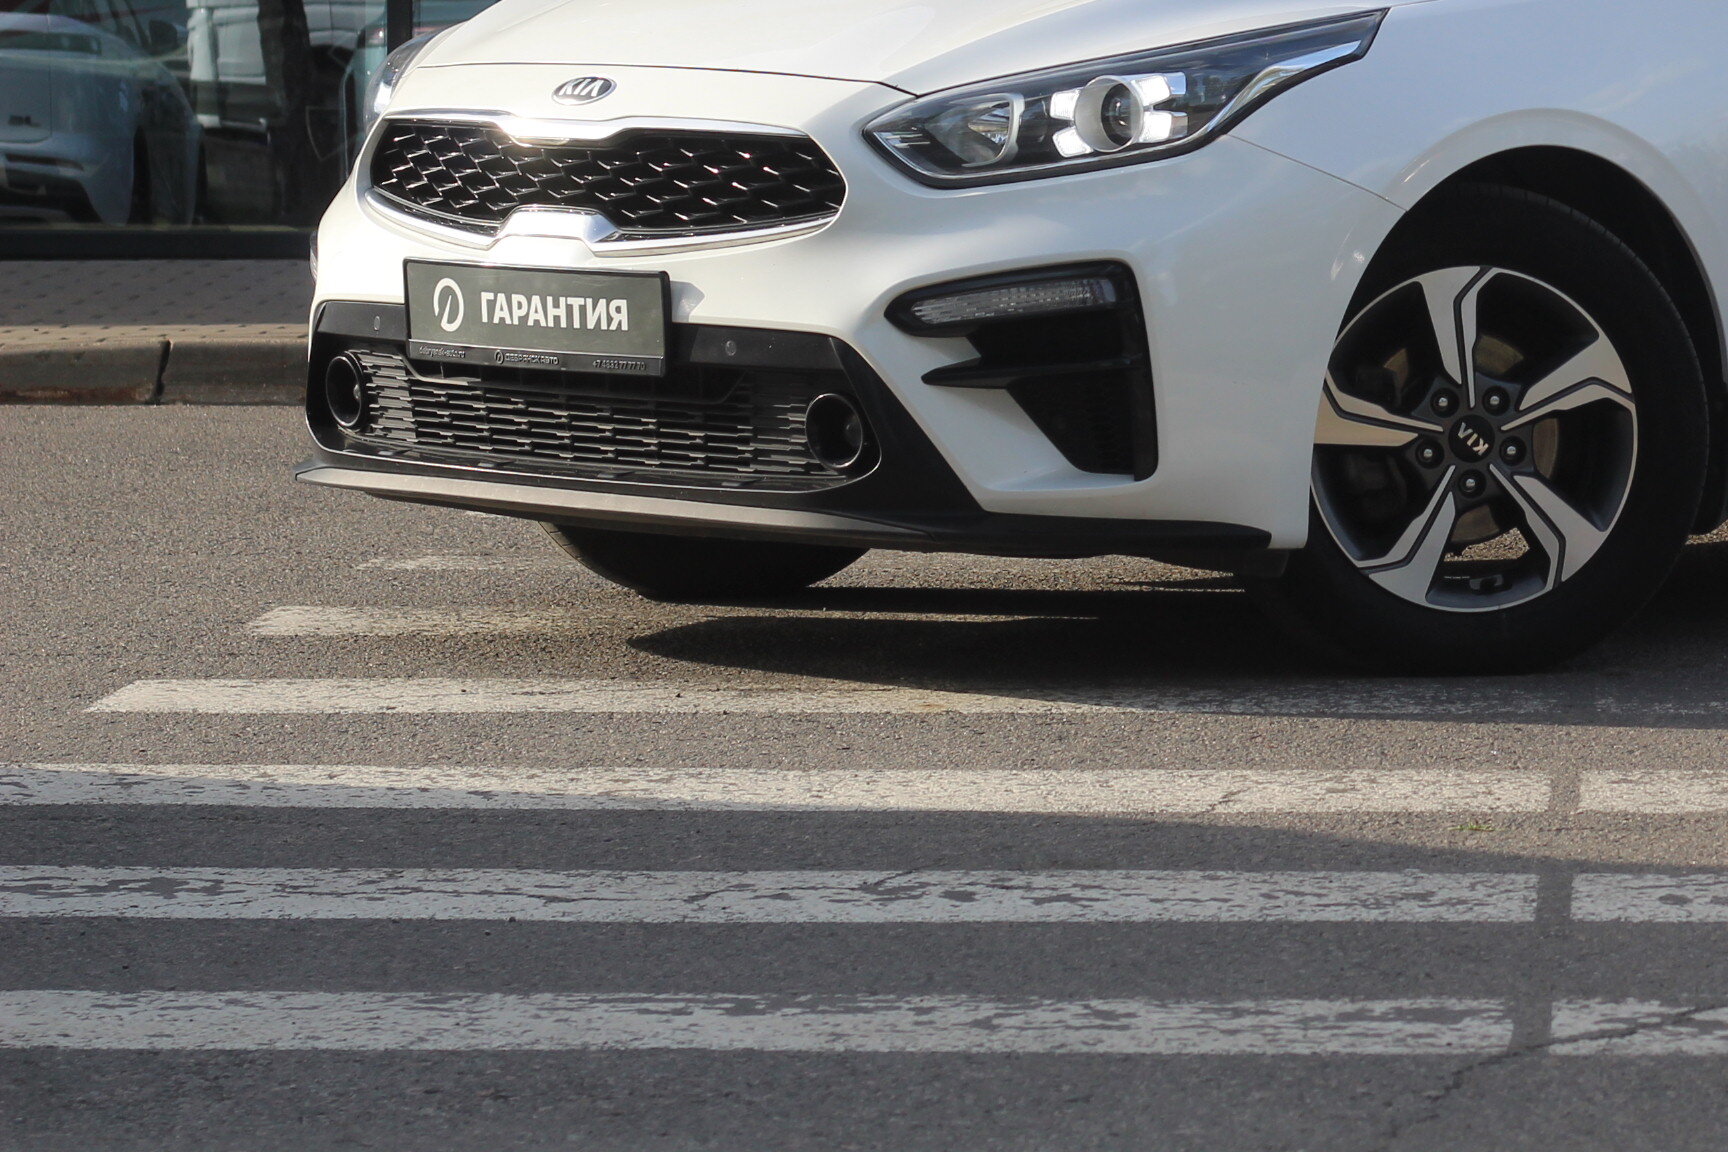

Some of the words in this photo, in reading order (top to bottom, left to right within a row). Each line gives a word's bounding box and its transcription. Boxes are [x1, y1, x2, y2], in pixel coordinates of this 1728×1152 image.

[558, 78, 605, 98] KIA
[480, 290, 630, 332] ГАРАНТИЯ
[1457, 421, 1490, 457] KIA
